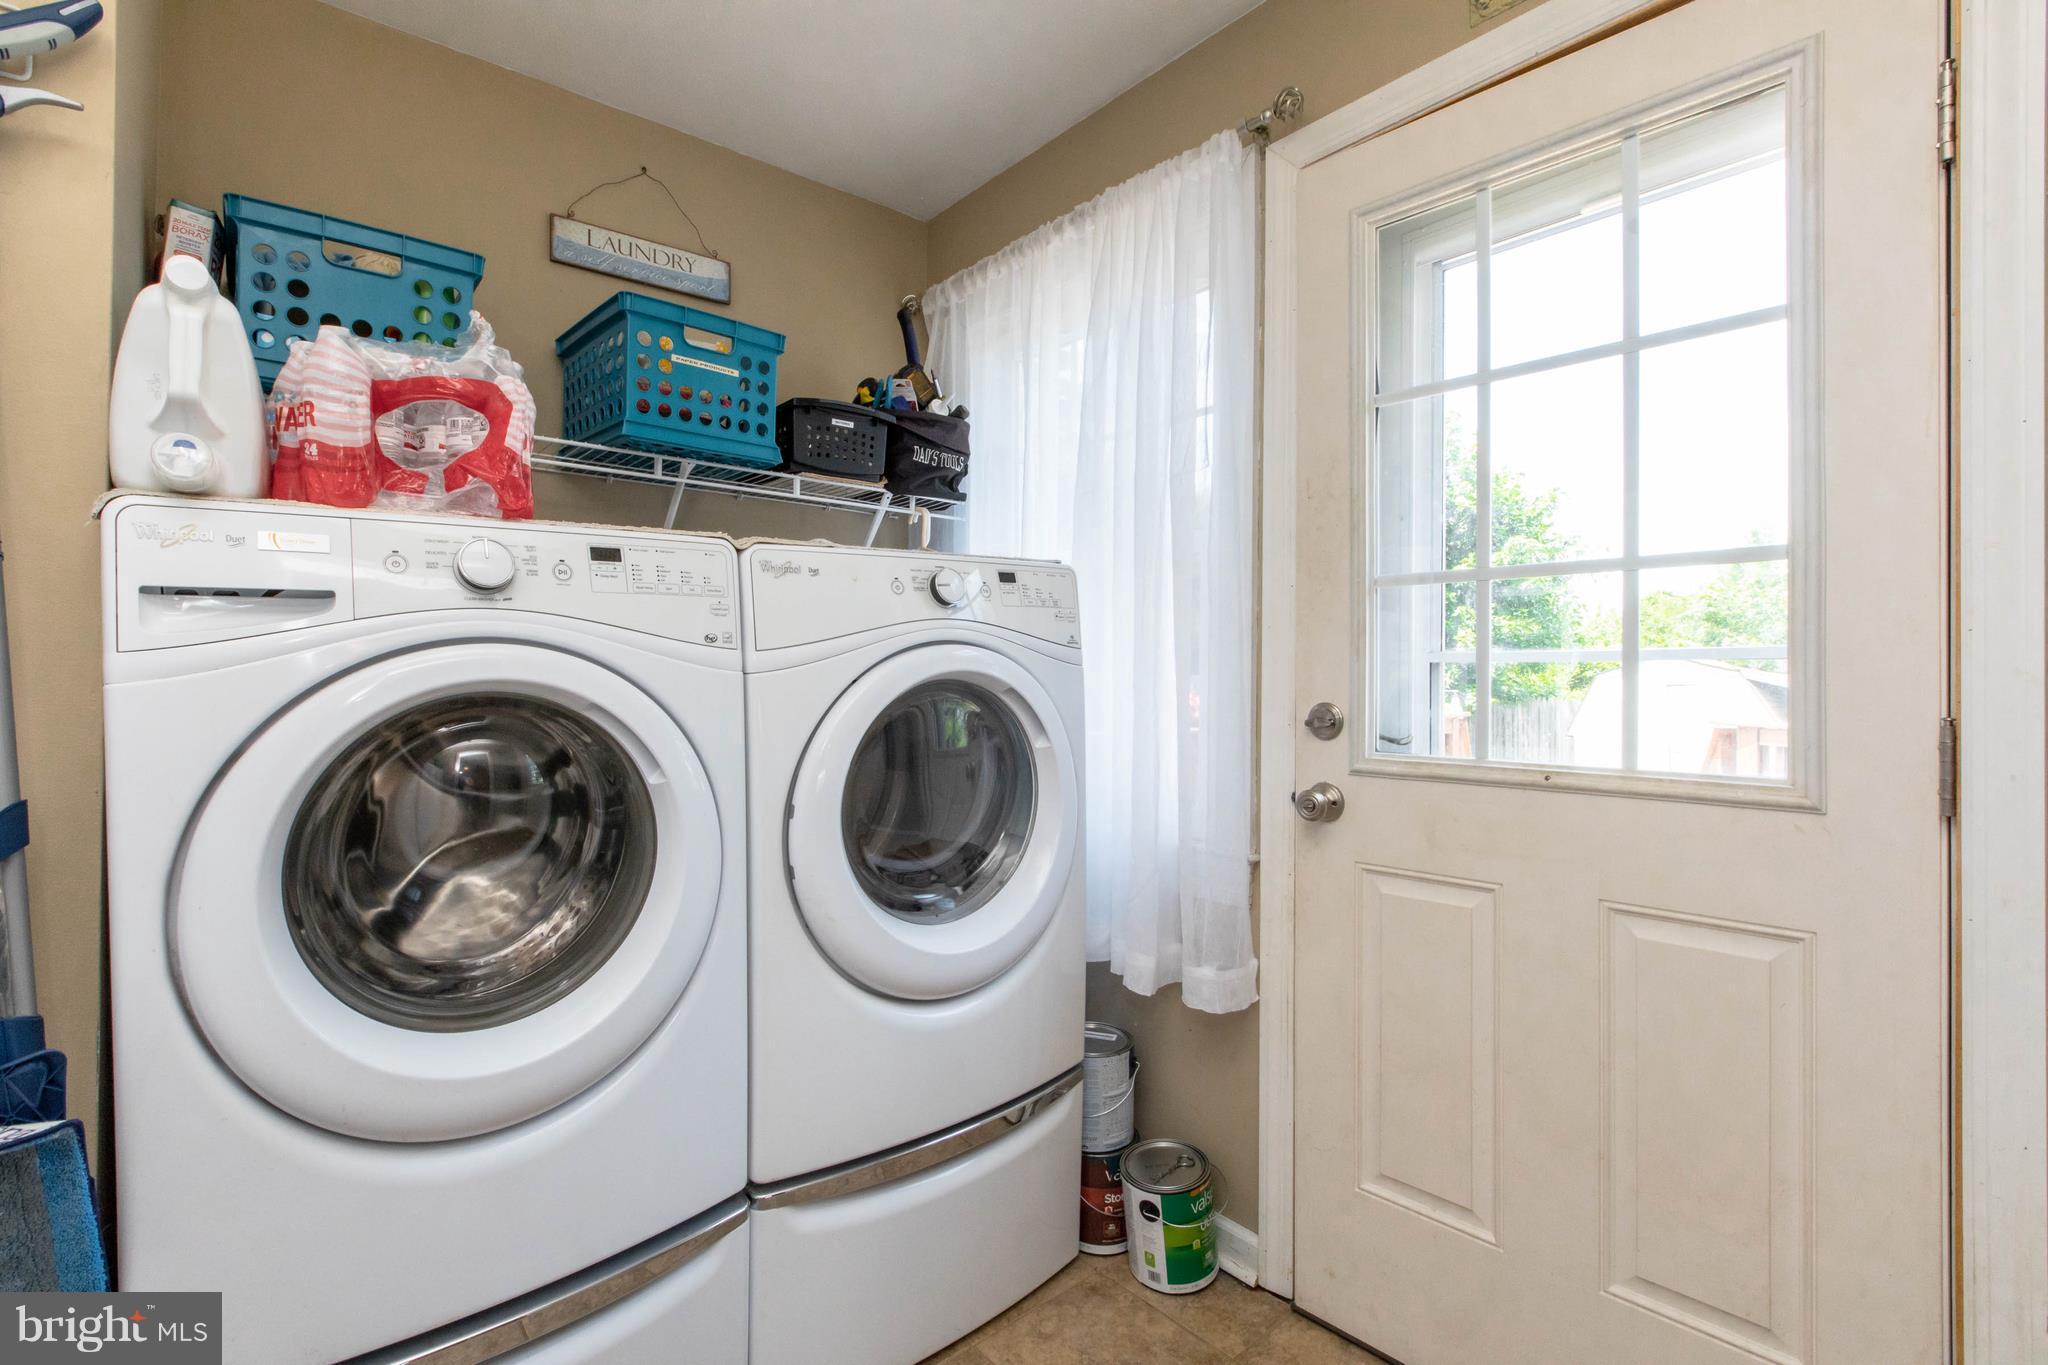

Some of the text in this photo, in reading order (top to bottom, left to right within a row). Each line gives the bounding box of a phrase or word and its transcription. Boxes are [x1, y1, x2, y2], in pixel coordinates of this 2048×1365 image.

[172, 224, 209, 241] BORAX
[587, 228, 697, 273] LAUNDRY
[912, 445, 965, 472] DAD'S TOOLS
[131, 522, 215, 547] Whirlpool
[225, 533, 246, 544] Duet
[759, 560, 801, 577] Whirlpool
[1104, 1193, 1122, 1204] Sto
